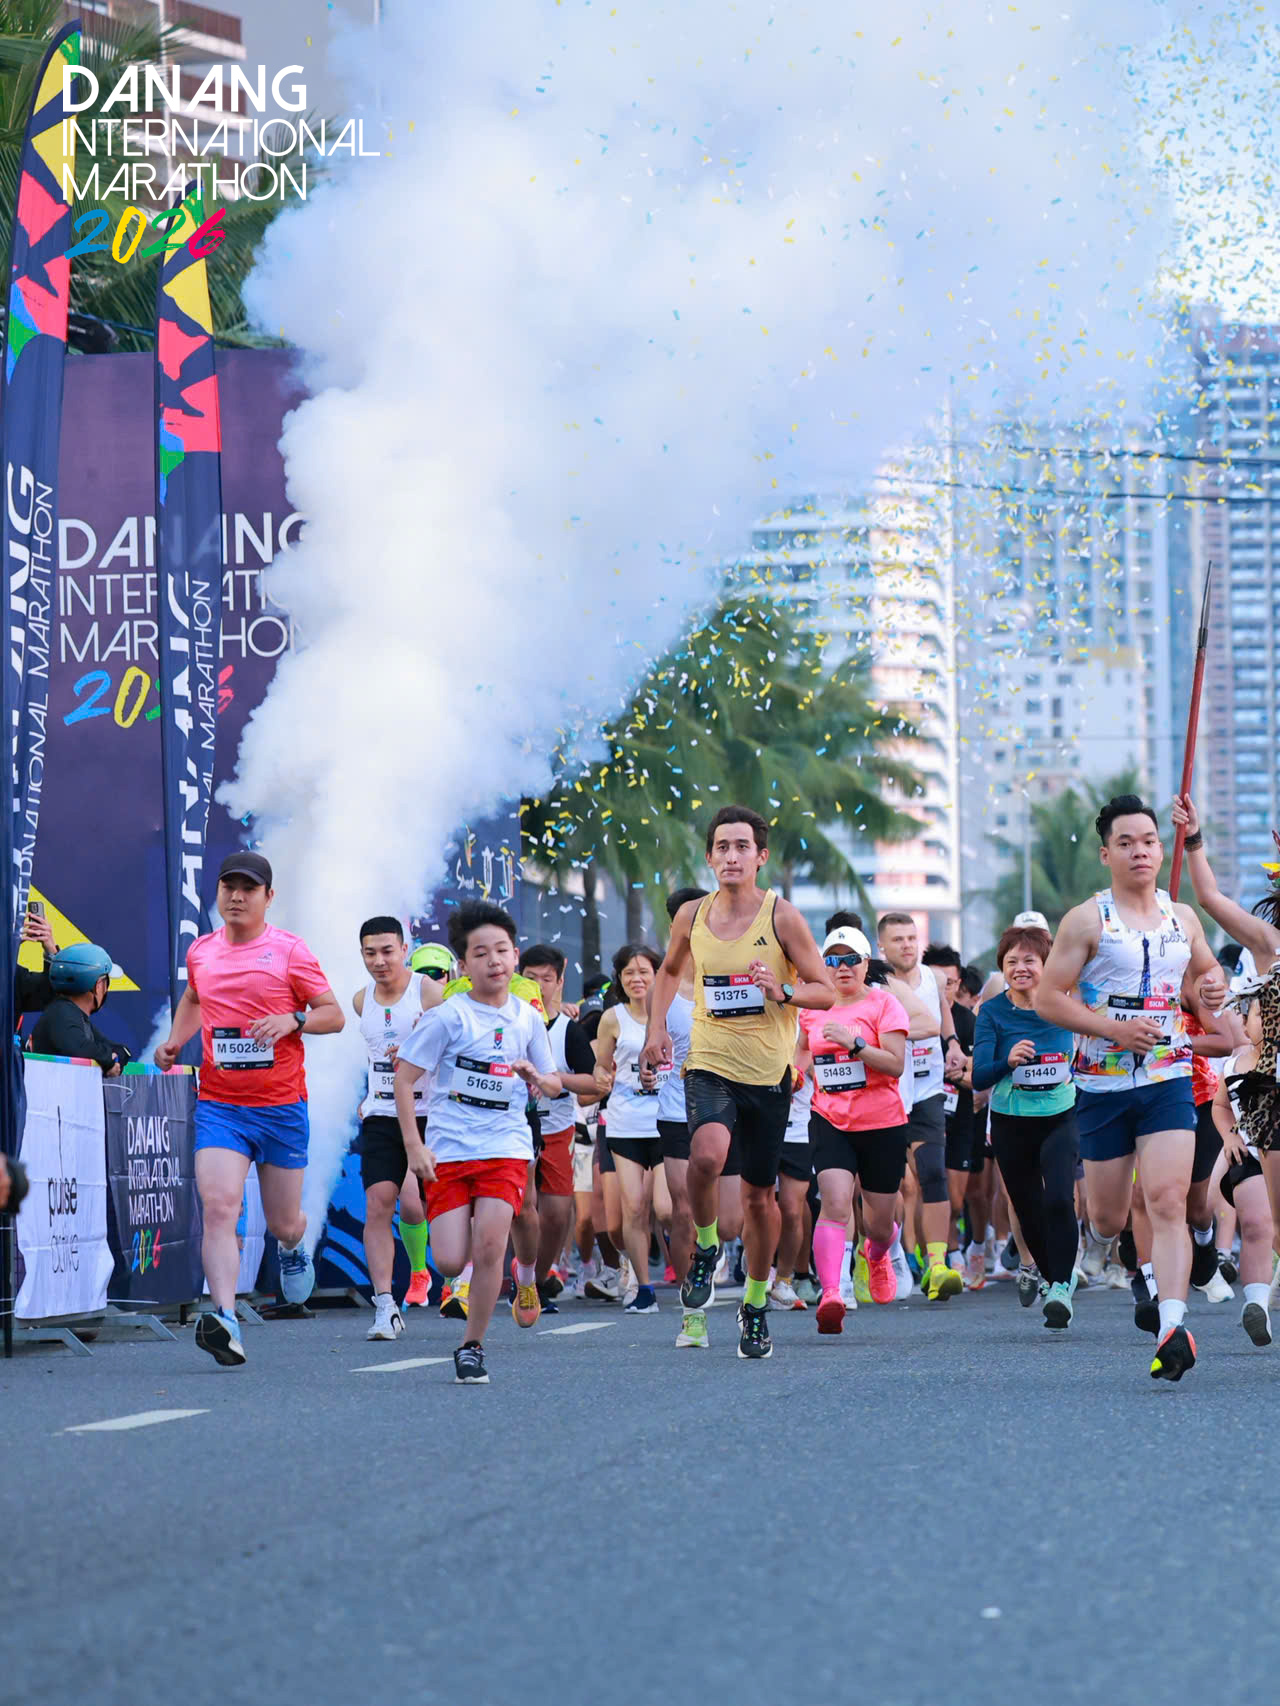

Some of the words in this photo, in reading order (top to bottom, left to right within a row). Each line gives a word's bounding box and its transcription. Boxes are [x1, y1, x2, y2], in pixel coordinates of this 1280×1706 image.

[28, 481, 54, 679] MARATHON
[191, 580, 216, 750] MARATHON
[714, 989, 748, 1001] 51375
[217, 1043, 227, 1054] M
[467, 1075, 503, 1092] 51635
[823, 1066, 852, 1078] 51483
[1024, 1067, 1057, 1079] 51440
[48, 1177, 78, 1228] pulse
[129, 1192, 174, 1226] MARATHON
[131, 1228, 162, 1275] 2026
